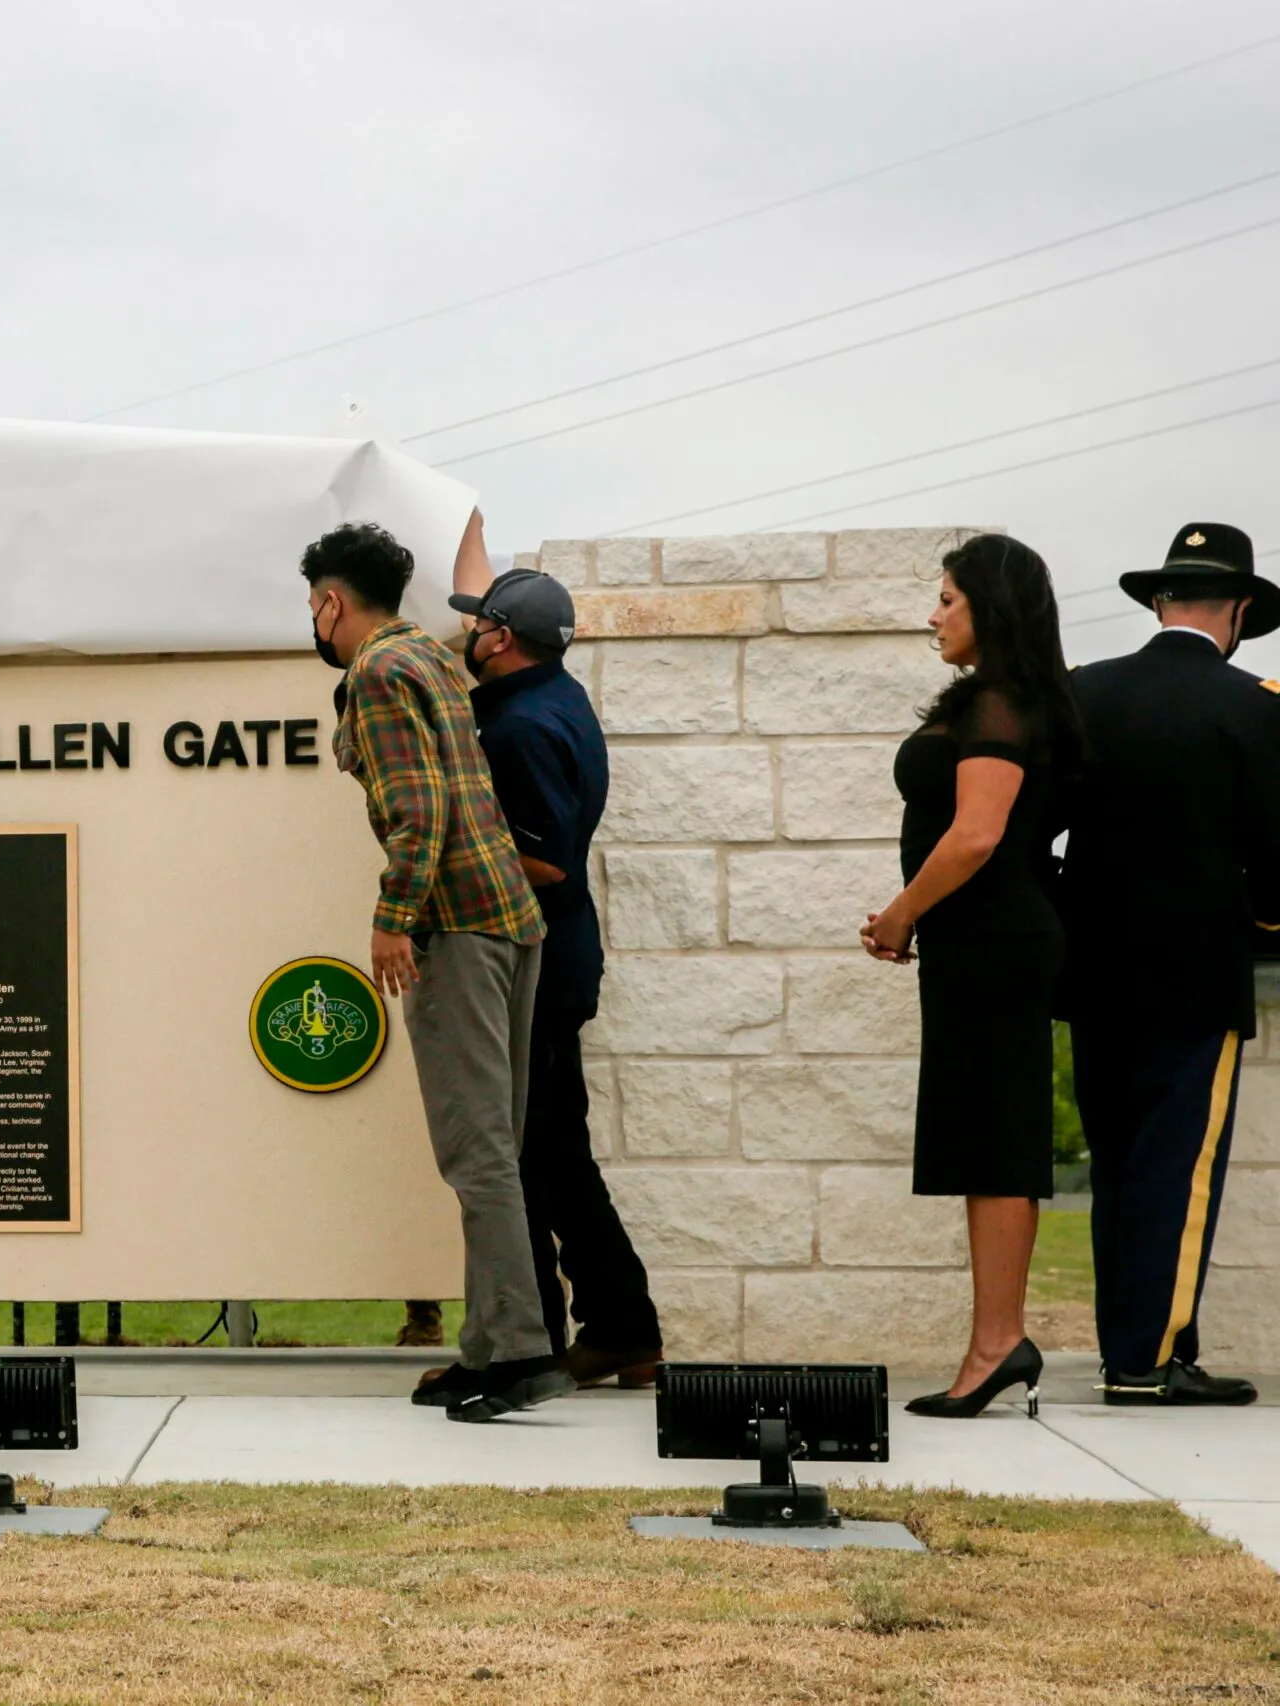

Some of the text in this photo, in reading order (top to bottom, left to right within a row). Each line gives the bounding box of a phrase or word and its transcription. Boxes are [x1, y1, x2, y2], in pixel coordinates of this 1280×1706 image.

[163, 718, 320, 768] GATE
[271, 1002, 361, 1025] BRAVE RIFLES
[311, 1038, 325, 1055] 3
